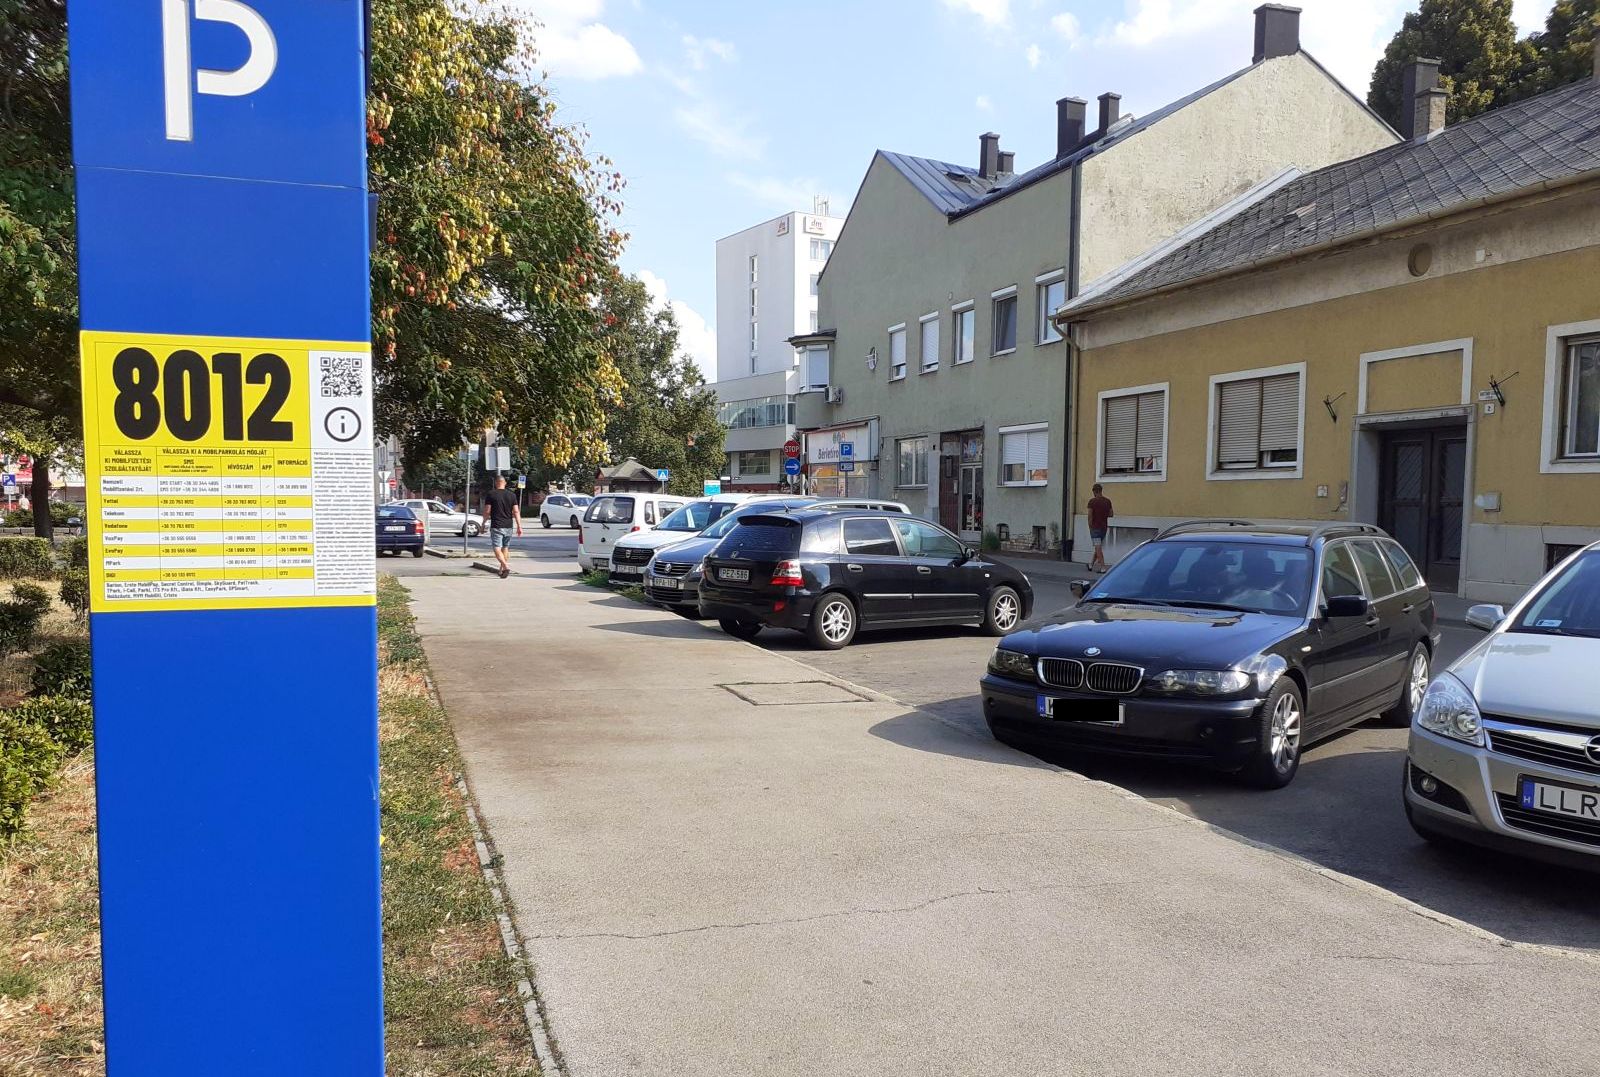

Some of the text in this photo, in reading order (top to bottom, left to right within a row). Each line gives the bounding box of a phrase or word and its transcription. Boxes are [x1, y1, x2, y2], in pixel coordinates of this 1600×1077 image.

[112, 346, 294, 442] 8012
[843, 445, 850, 454] P
[1524, 786, 1598, 818] H LLR
